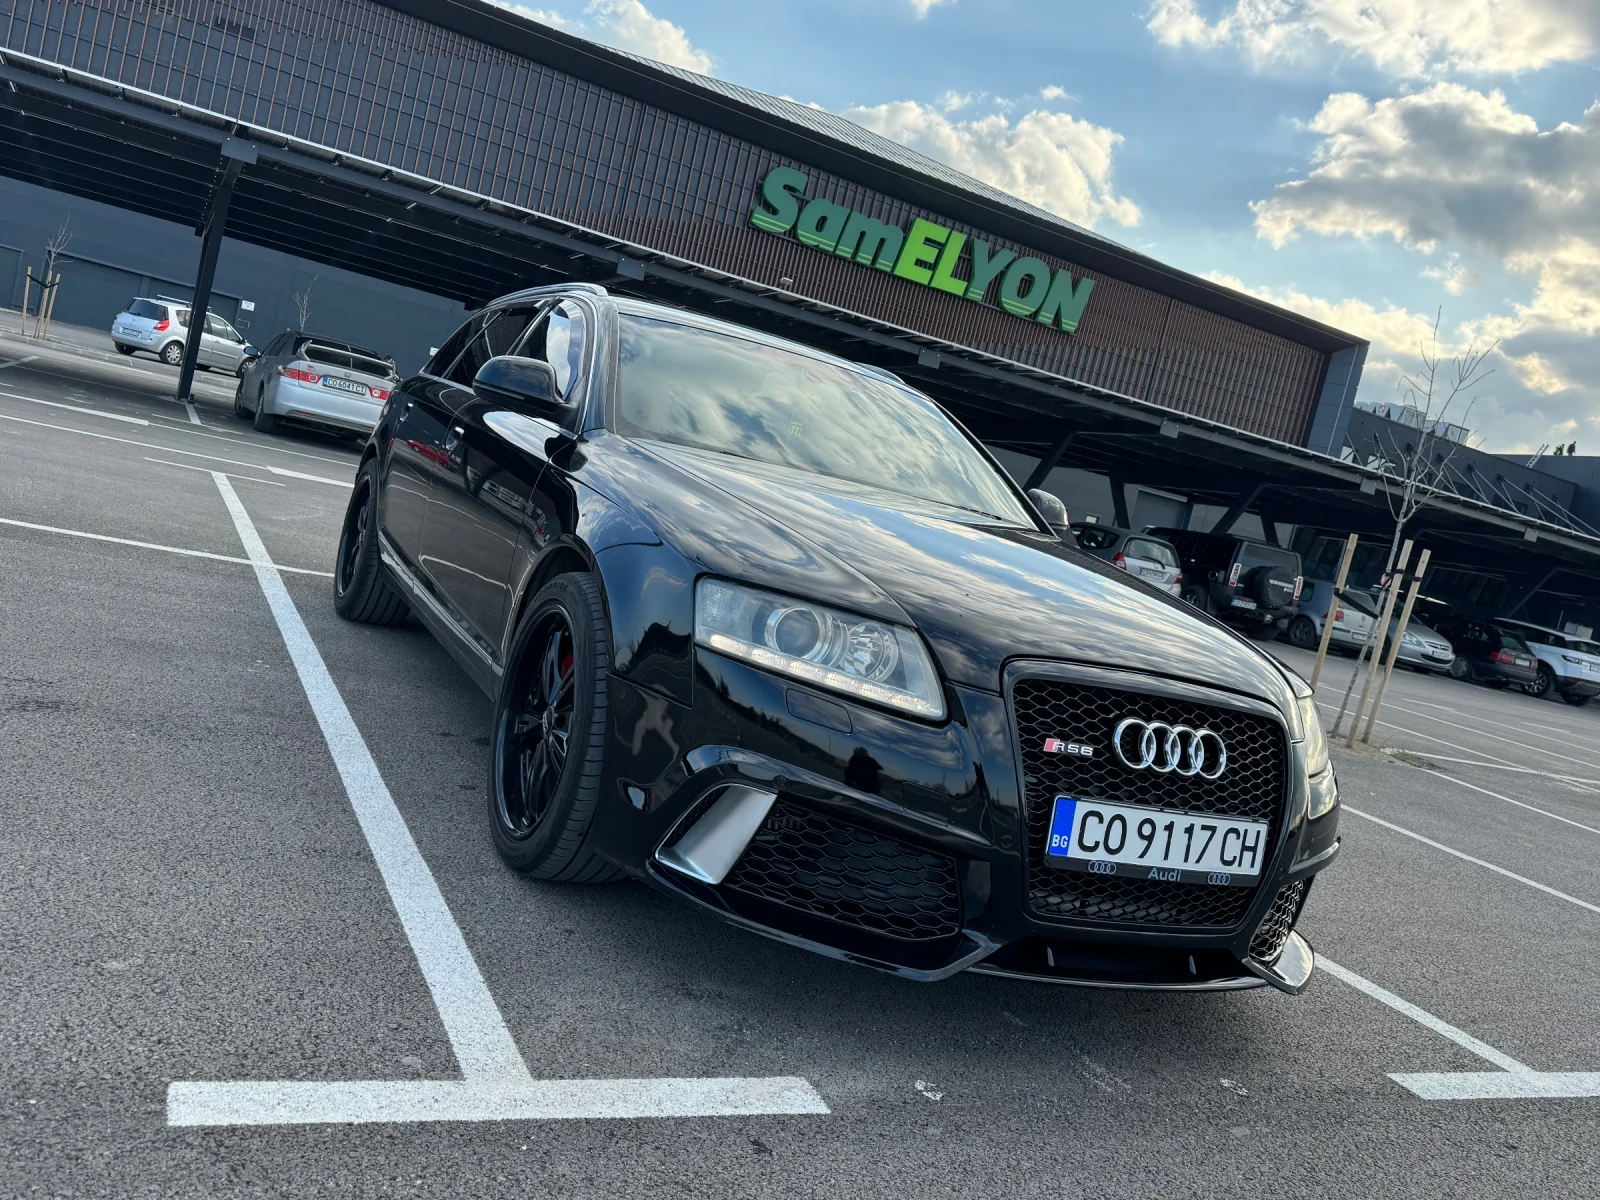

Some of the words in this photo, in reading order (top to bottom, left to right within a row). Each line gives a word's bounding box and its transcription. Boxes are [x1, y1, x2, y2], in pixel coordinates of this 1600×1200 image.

[750, 166, 1096, 334] SamELYON
[328, 378, 337, 387] CO
[355, 384, 365, 393] CT
[1052, 741, 1094, 757] RS6
[1051, 834, 1069, 848] BG
[1077, 809, 1128, 856] CO
[1137, 817, 1218, 864] 9117
[1219, 827, 1261, 869] CH
[1147, 866, 1182, 882] Audi
